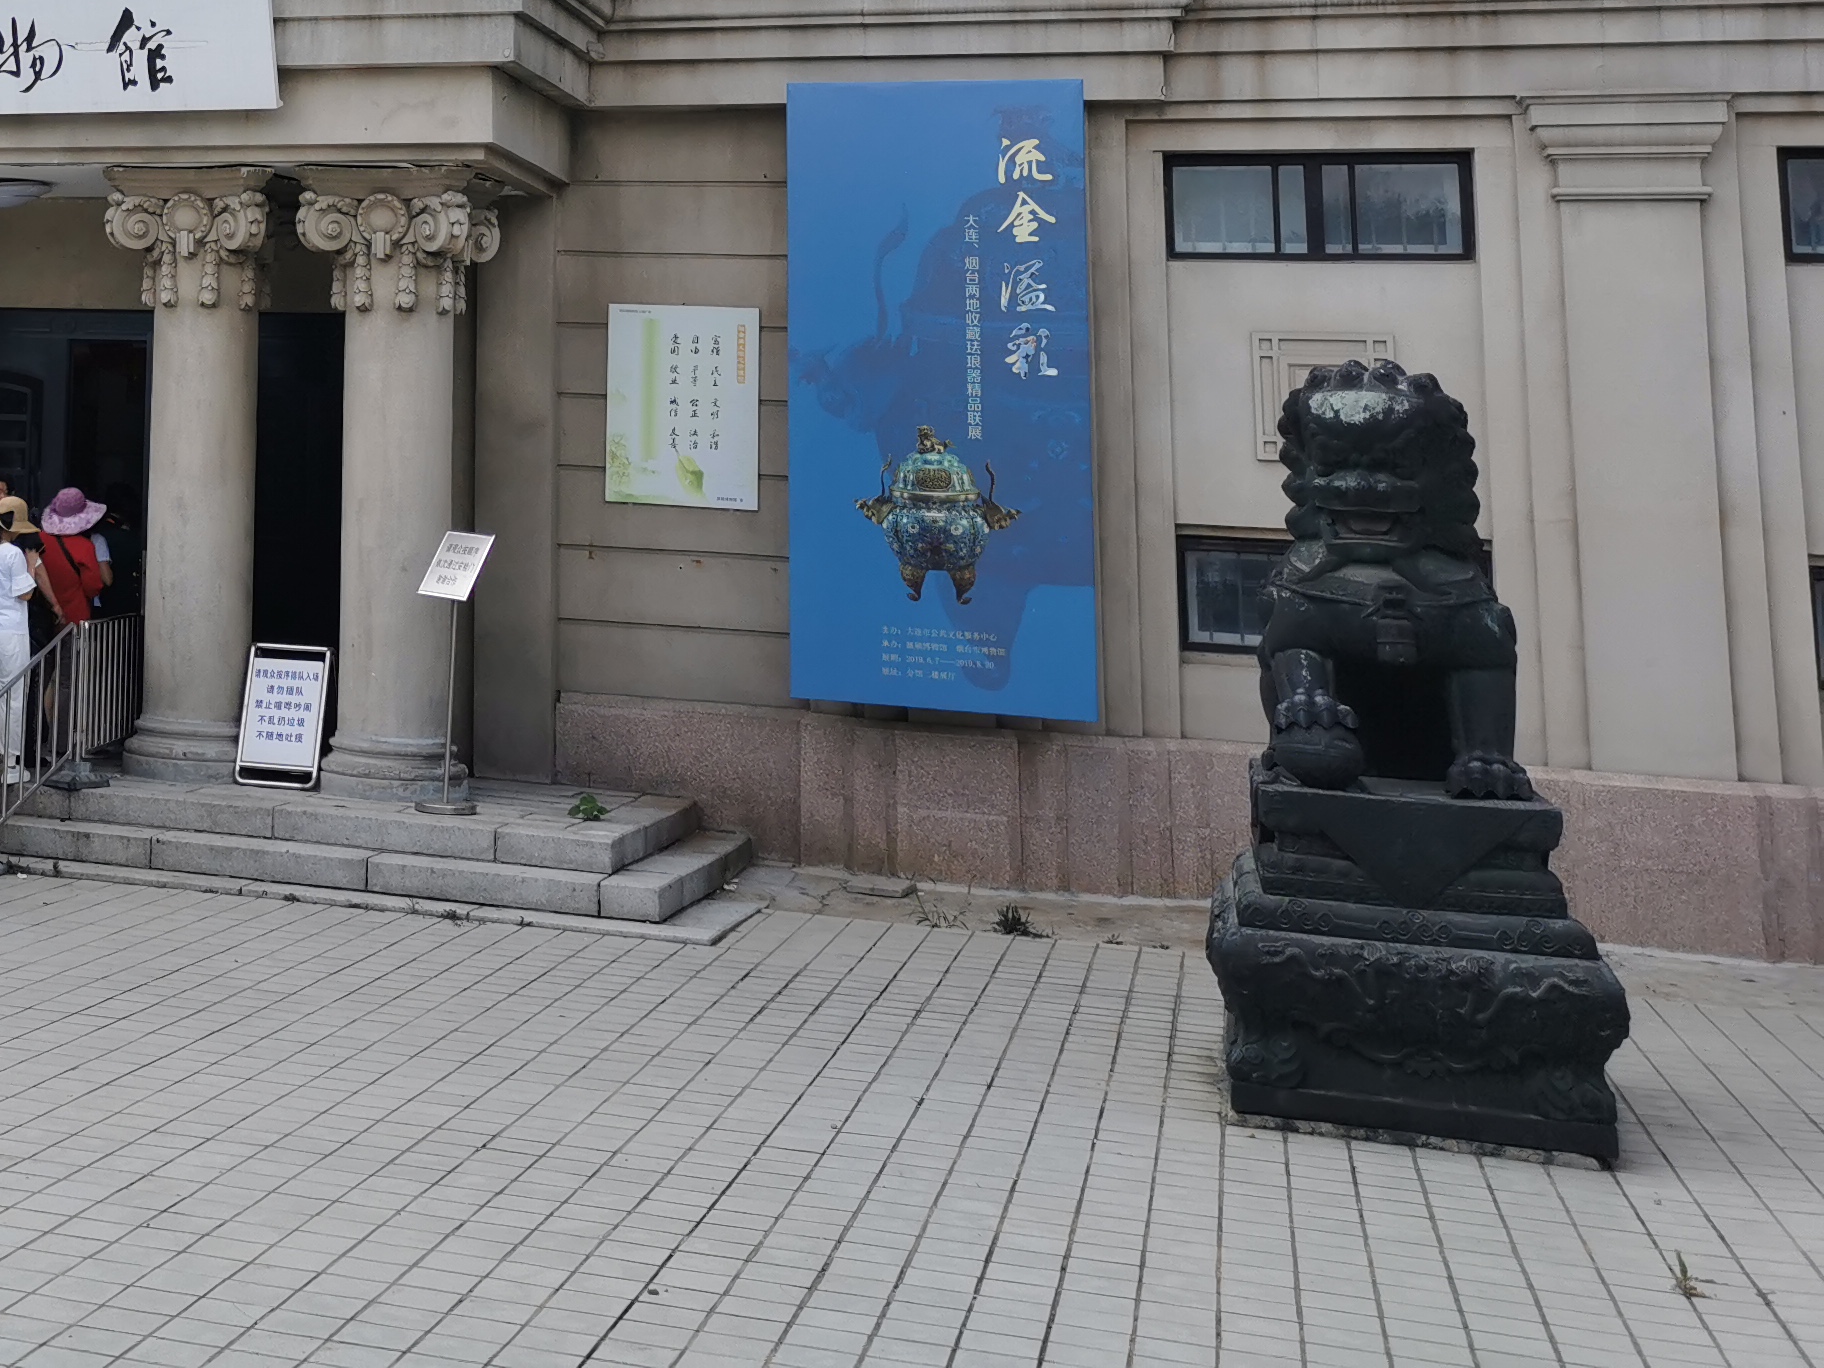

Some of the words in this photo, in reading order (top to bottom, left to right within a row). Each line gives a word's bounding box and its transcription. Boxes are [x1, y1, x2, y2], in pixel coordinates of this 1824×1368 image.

[997, 137, 1059, 379] 流金溢彩
[255, 668, 319, 682] 请观众按序排队入场
[266, 684, 304, 696] 请勿插队
[255, 699, 312, 712] 禁止喧哗吵闹
[257, 714, 305, 727] 不乱扔垃圾
[255, 730, 304, 743] 不随地吐痰
